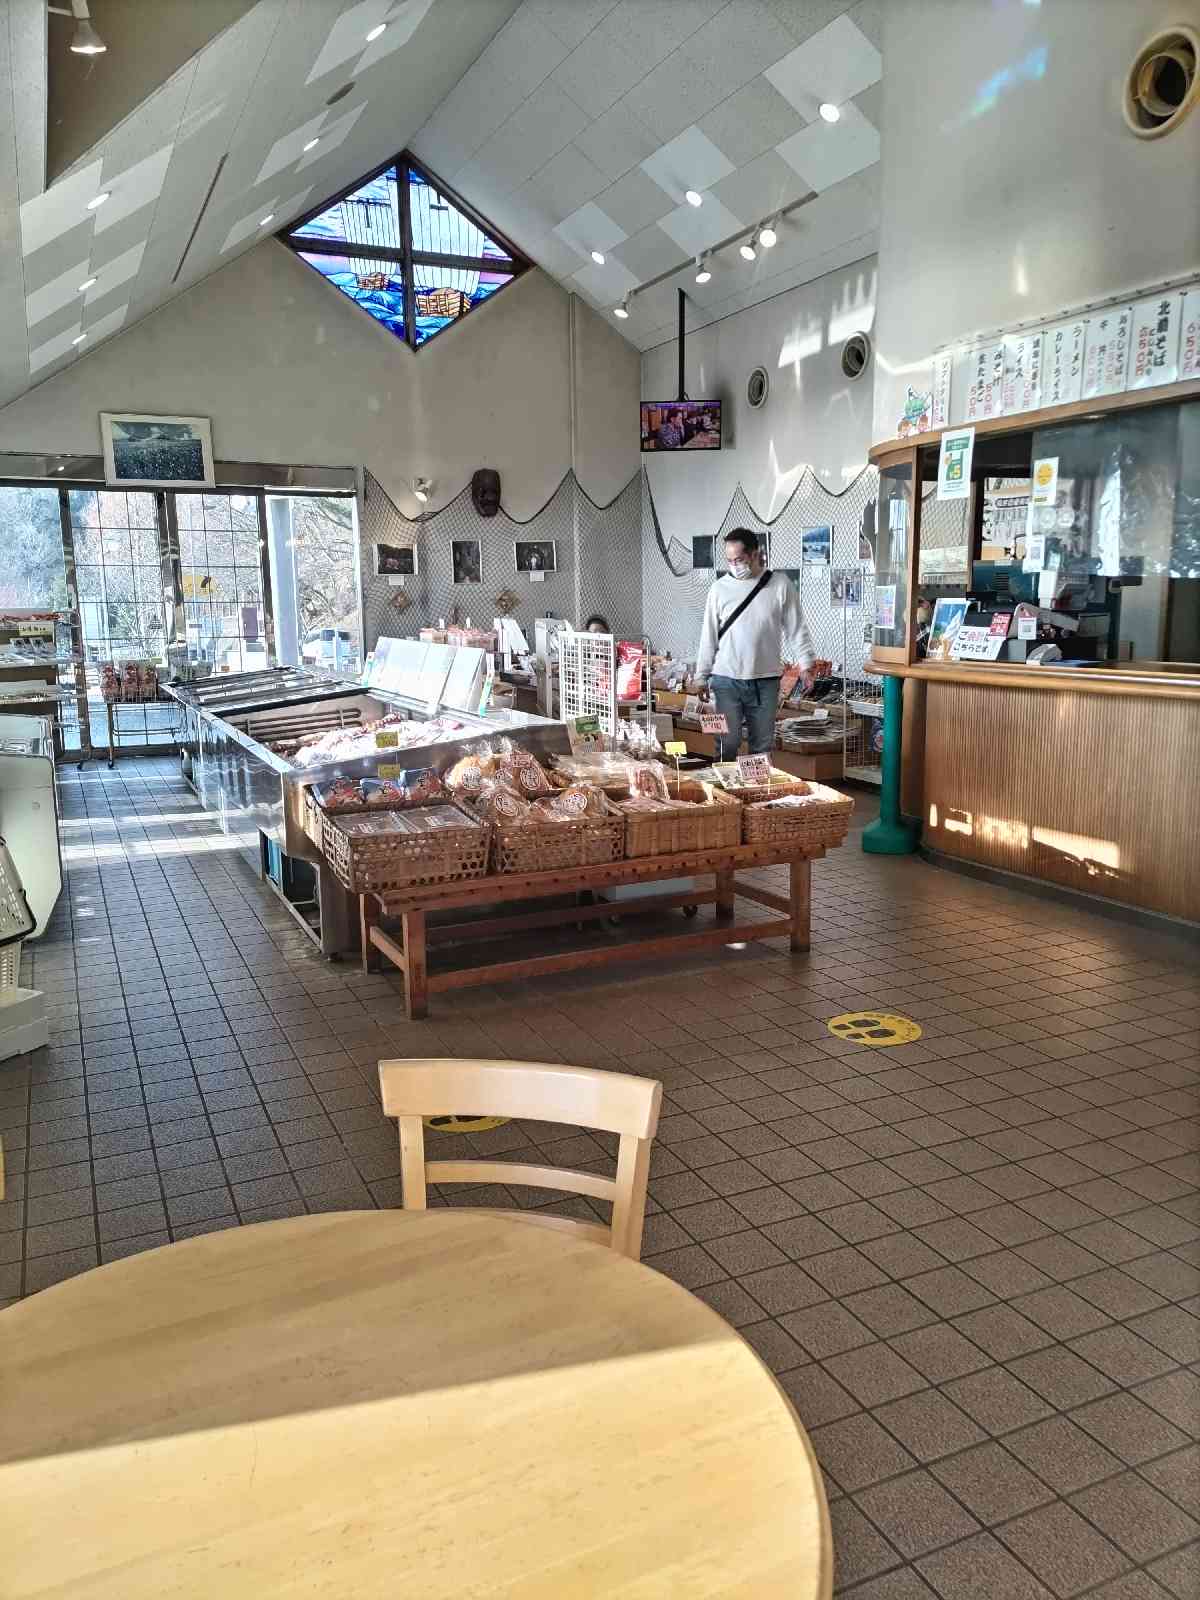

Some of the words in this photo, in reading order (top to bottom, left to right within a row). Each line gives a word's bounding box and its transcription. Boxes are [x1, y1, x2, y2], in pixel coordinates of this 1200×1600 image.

[1015, 342, 1025, 379] ライス
[1051, 331, 1063, 402] カレーライス
[1071, 325, 1083, 377] ラーメン
